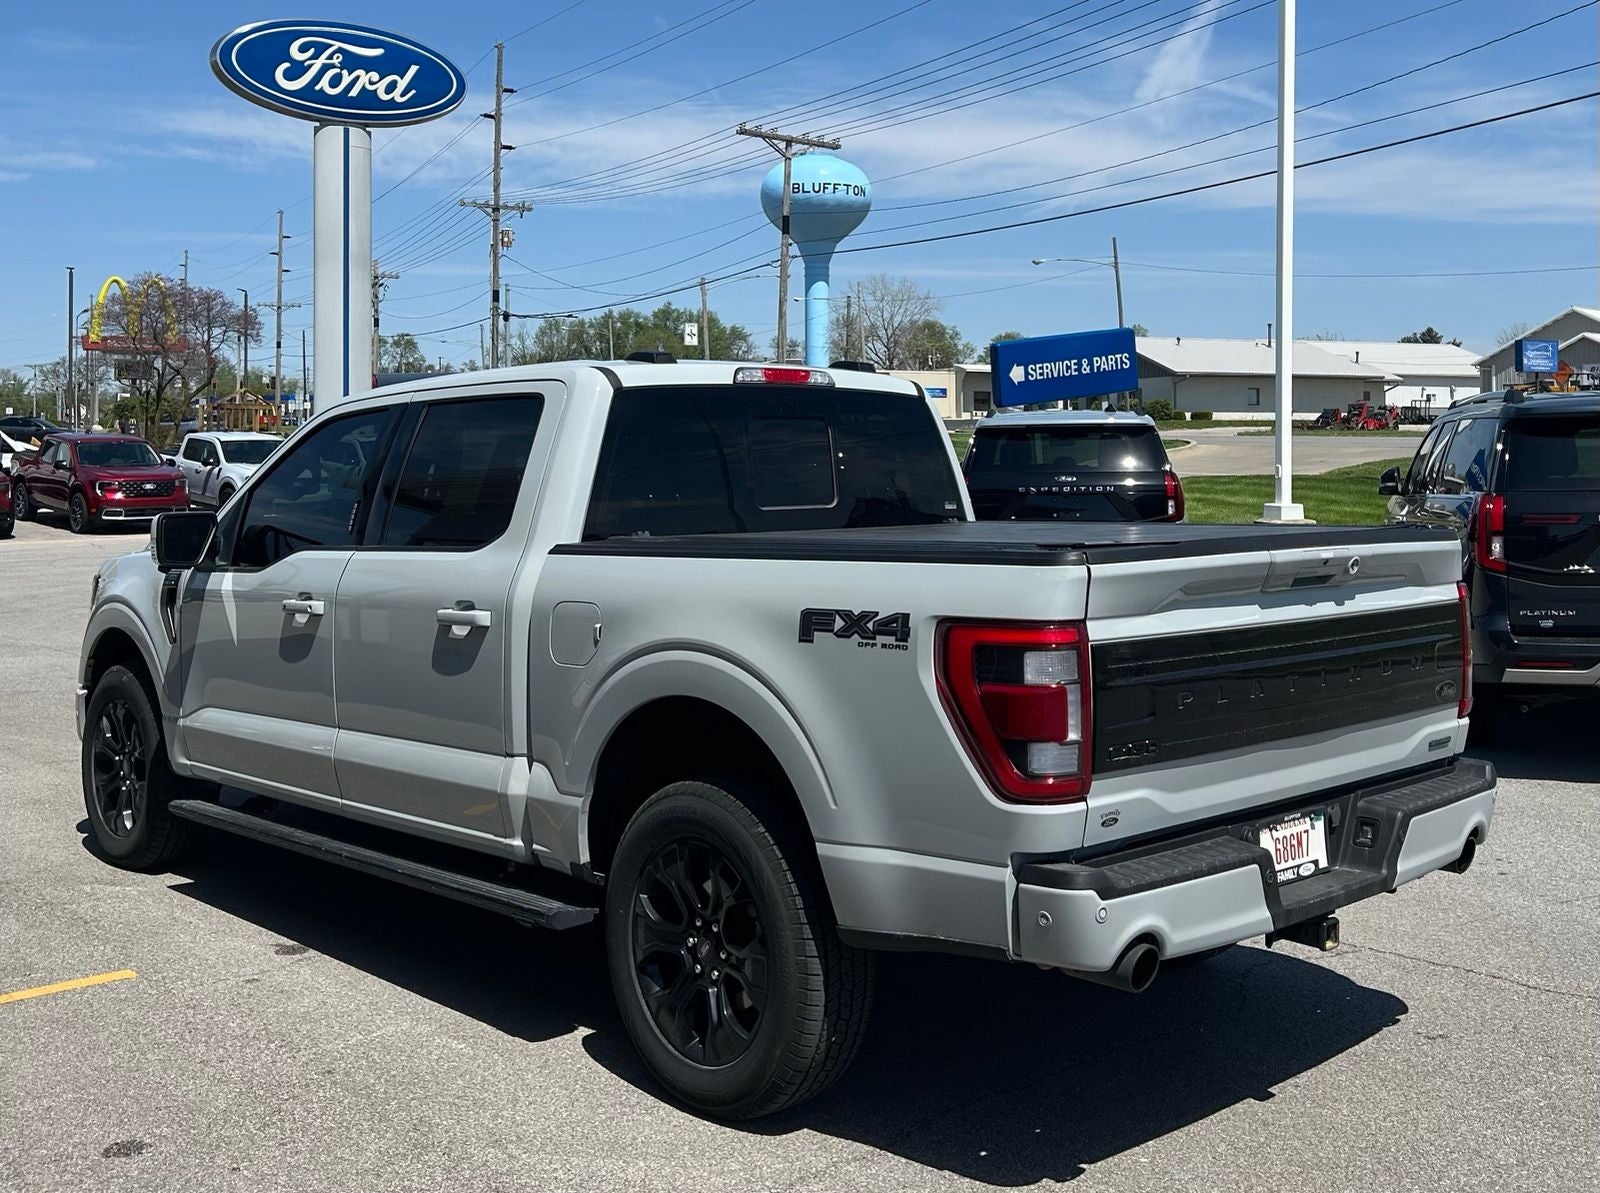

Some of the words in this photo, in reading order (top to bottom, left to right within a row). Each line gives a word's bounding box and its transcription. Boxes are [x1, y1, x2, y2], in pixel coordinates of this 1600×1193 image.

[275, 36, 420, 103] Ford
[791, 182, 866, 197] BLUFFTON
[1028, 359, 1079, 381] SERVICE
[1081, 358, 1091, 374] &
[1093, 352, 1131, 373] PARTS
[1018, 486, 1115, 494] EXPEDITION
[798, 607, 911, 643] FX4
[857, 641, 878, 649] OFF
[880, 643, 909, 651] ROAD
[1177, 655, 1423, 710] PLATINUM
[1277, 867, 1298, 883] FAMILY
